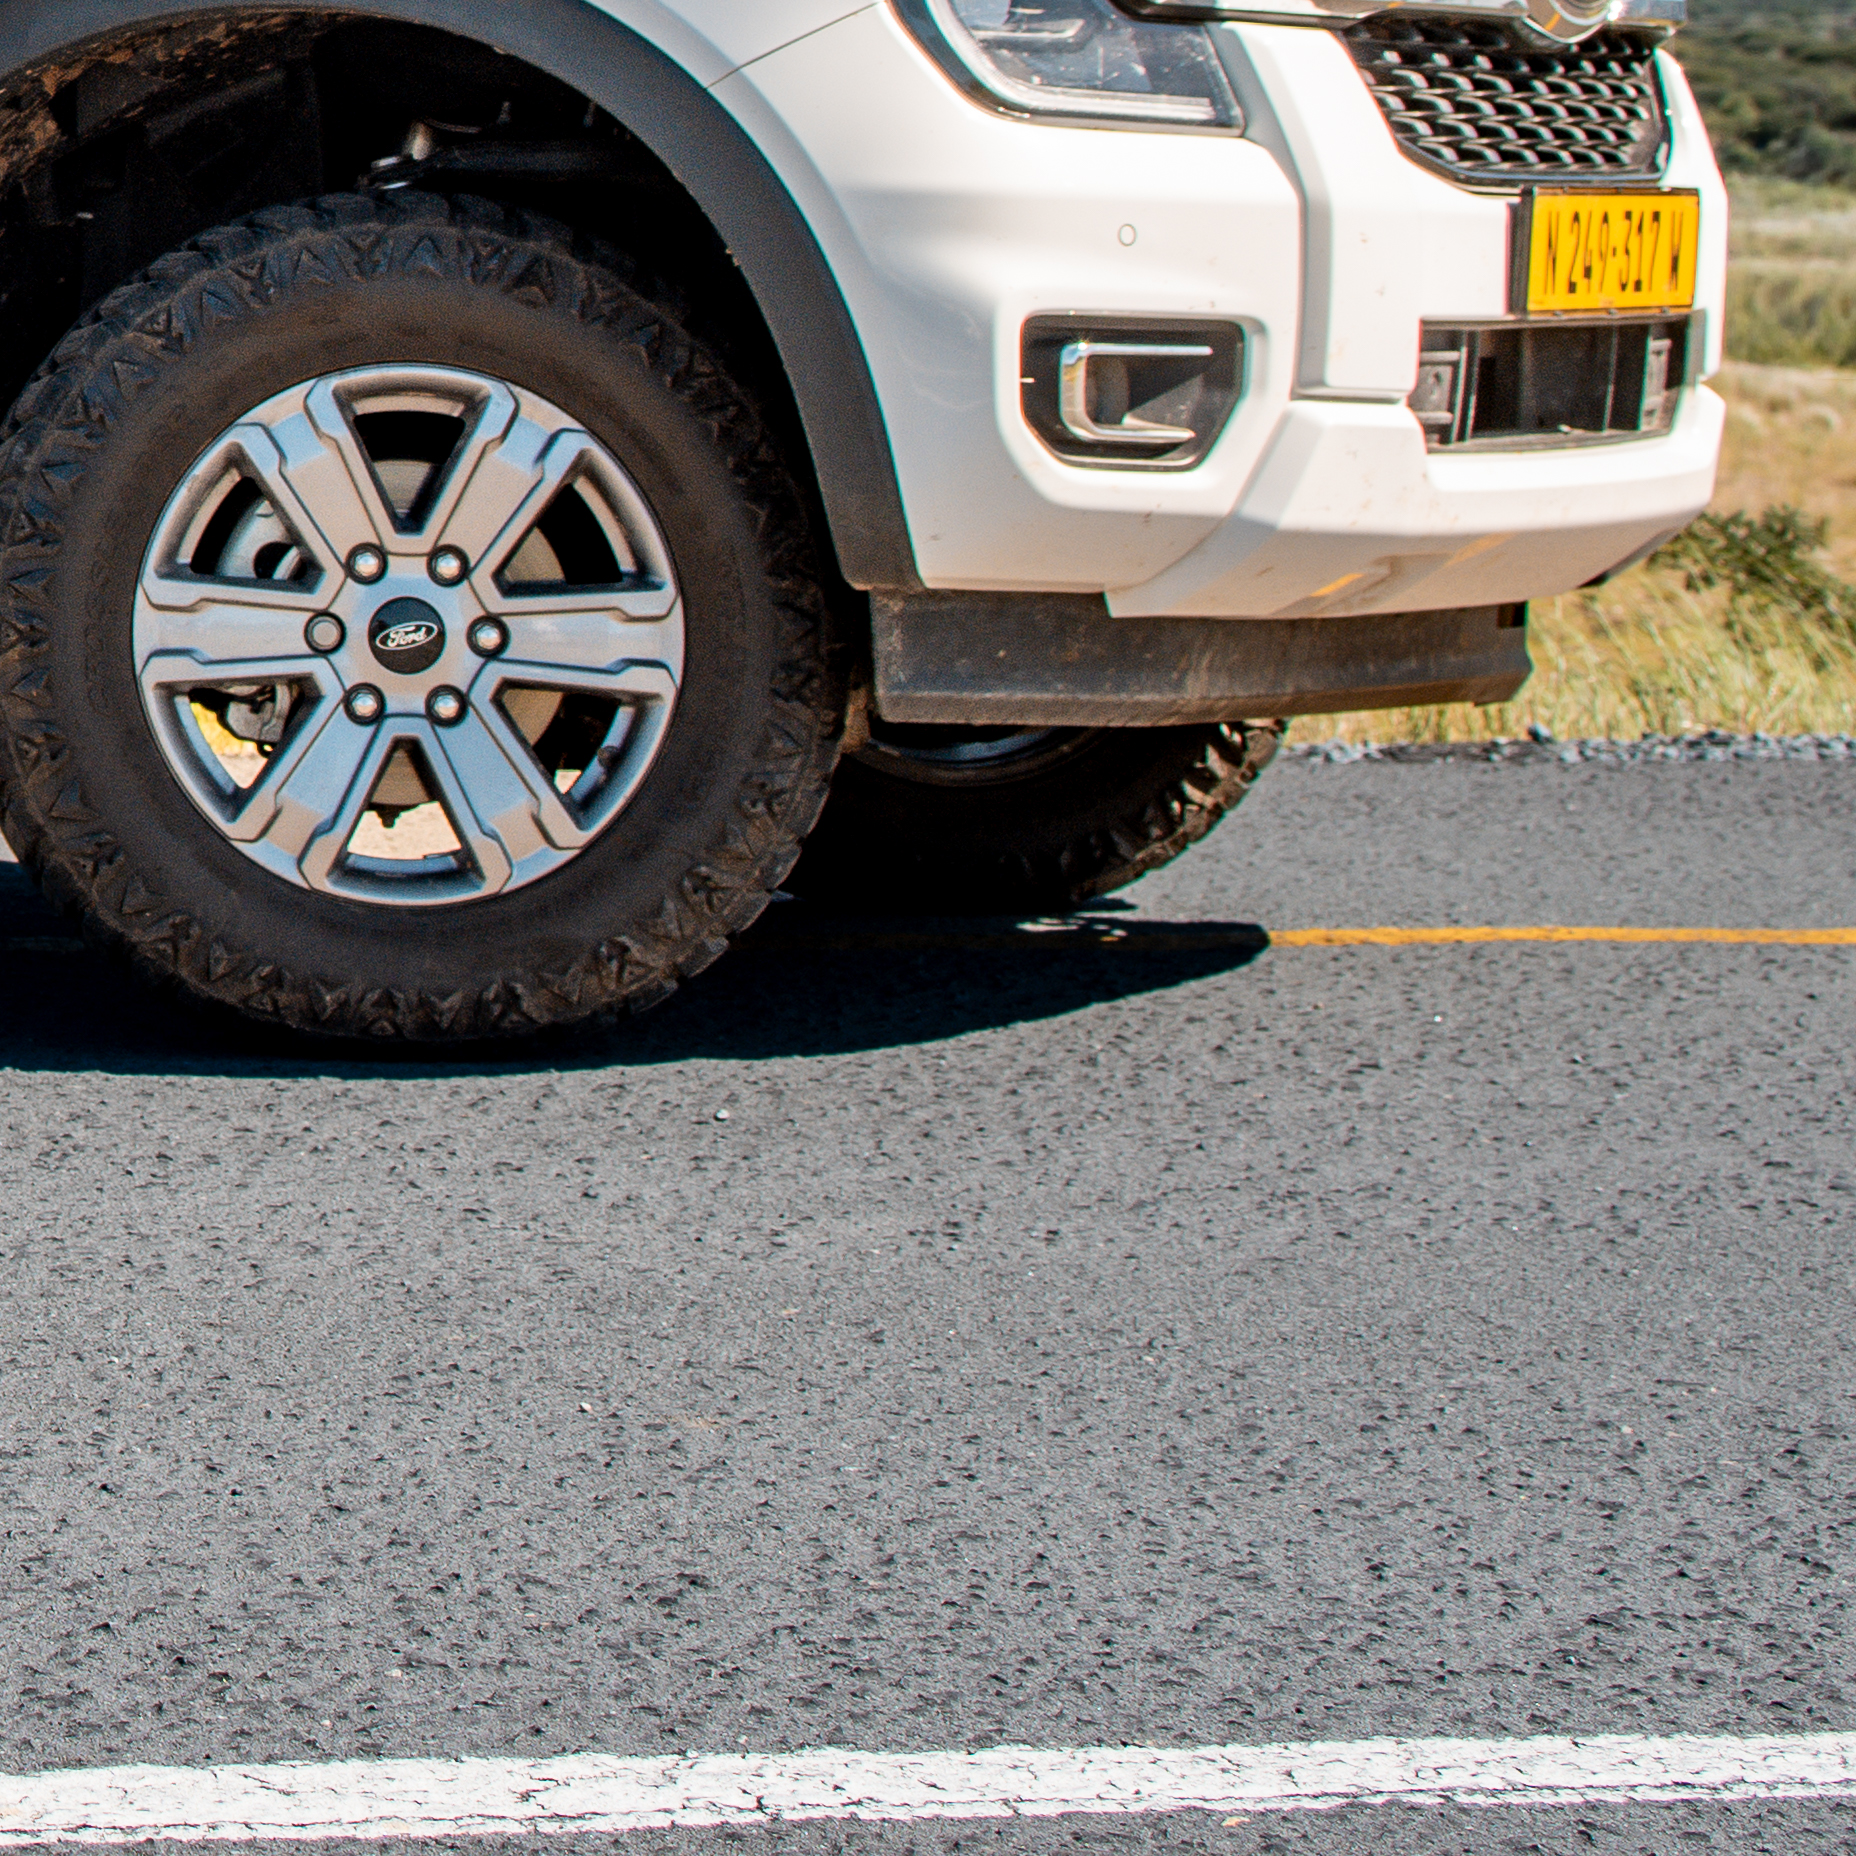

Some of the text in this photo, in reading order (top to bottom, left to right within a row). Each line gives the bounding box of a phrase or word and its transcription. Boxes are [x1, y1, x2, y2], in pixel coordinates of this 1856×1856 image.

[1544, 210, 1560, 295] N
[1568, 210, 1661, 295] 249-317
[387, 625, 428, 647] Ford
